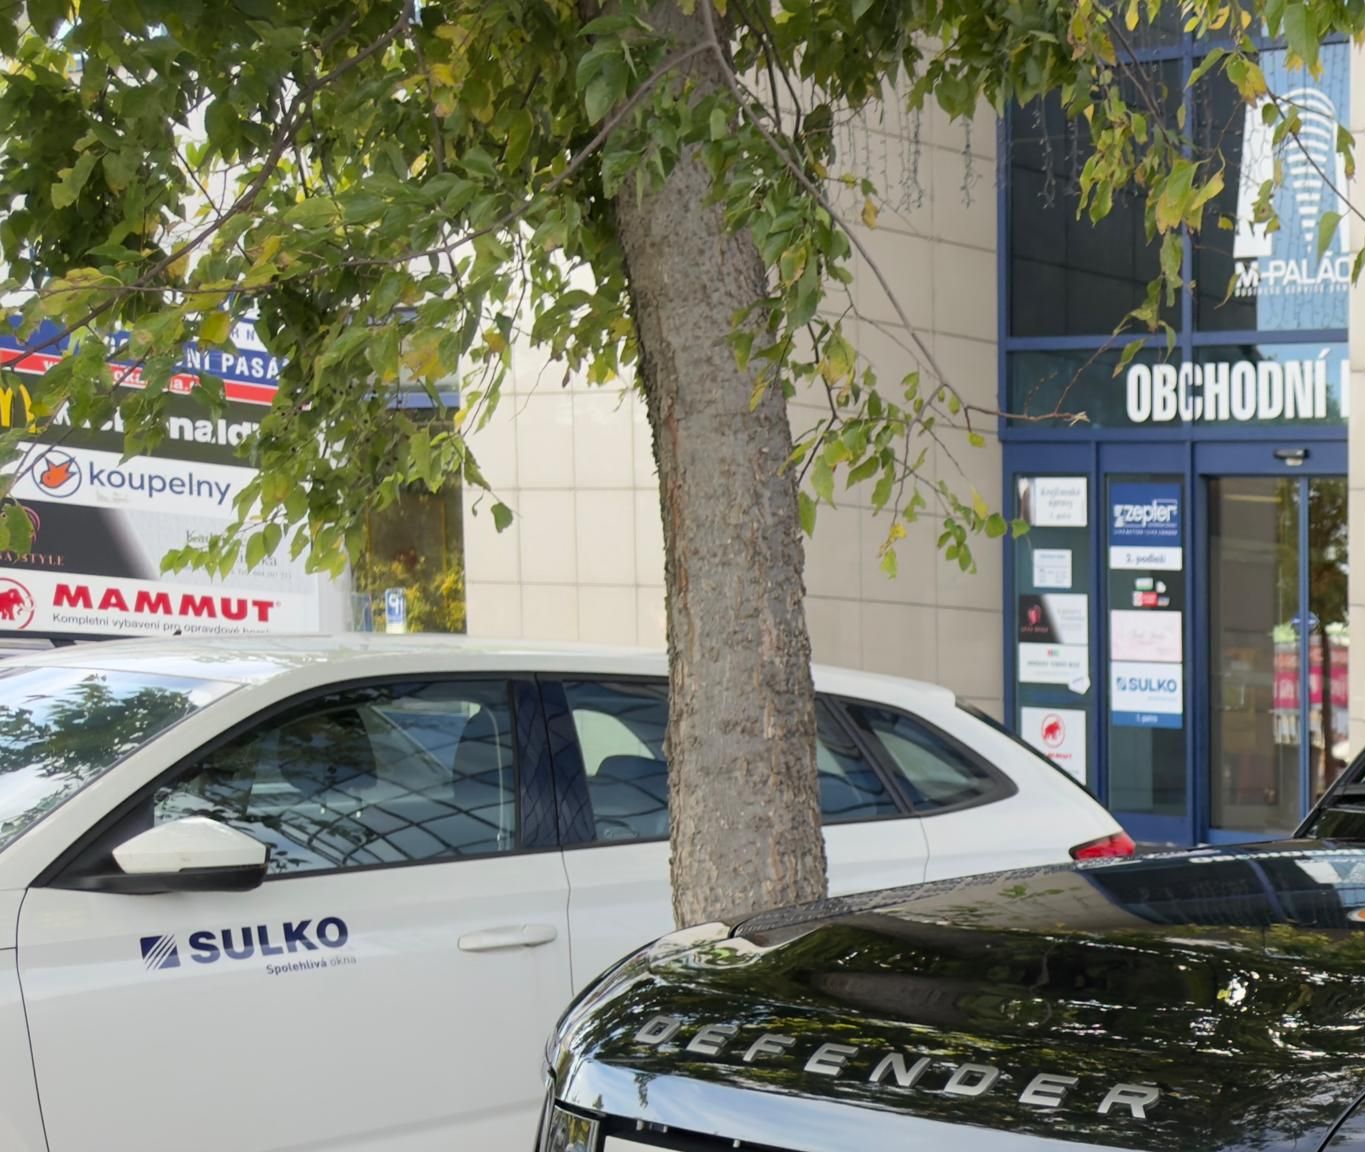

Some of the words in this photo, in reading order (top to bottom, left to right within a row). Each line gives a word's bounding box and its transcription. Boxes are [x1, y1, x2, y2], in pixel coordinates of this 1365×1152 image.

[1126, 348, 1330, 422] OBCHODNÍ
[89, 461, 231, 504] koupelny
[52, 583, 274, 623] MAMMUT
[1129, 677, 1177, 693] SULKO
[188, 915, 349, 964] SULKO
[266, 959, 328, 976] Spolehlivá
[635, 1015, 1160, 1119] DEFENDER
